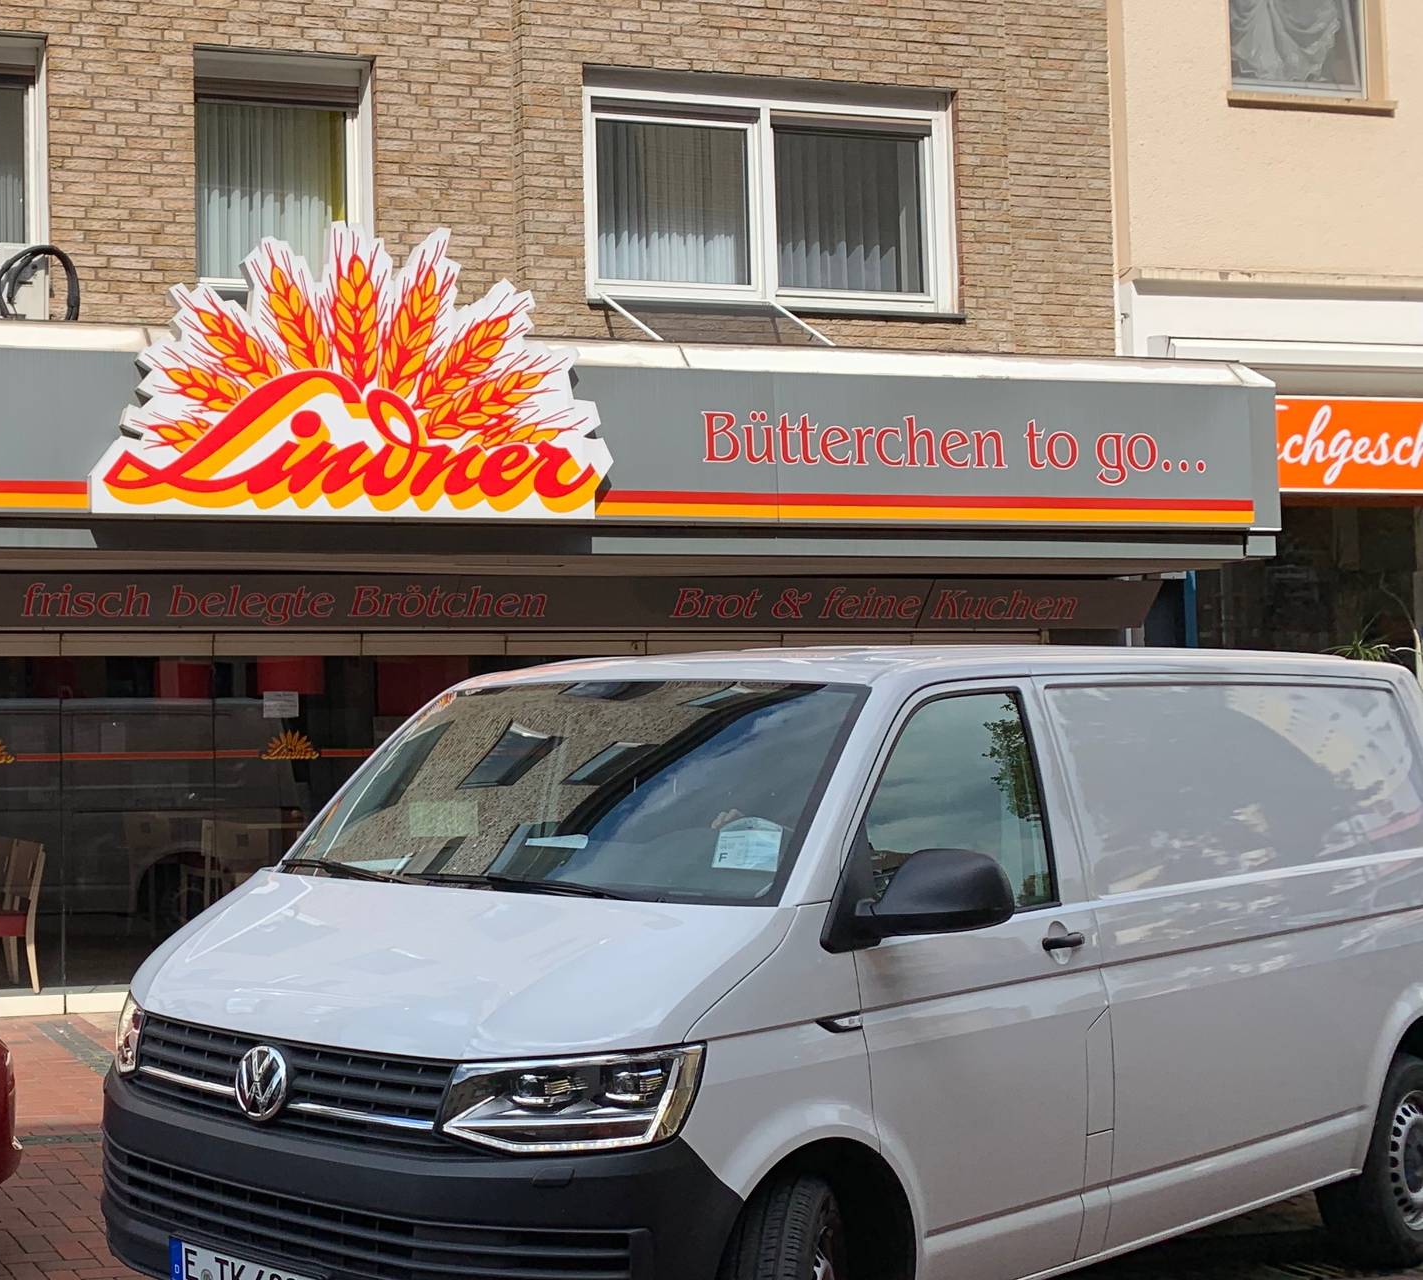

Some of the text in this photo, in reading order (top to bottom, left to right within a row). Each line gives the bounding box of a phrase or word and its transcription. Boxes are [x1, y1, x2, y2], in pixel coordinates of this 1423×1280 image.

[103, 369, 602, 513] Lindner
[701, 409, 1208, 487] Bütterchen to go...
[1275, 404, 1423, 486] chgesc
[20, 582, 548, 626] frisch belegte Brötchen
[669, 587, 1078, 620] Brot & feine Kuchen
[184, 1247, 199, 1280] E
